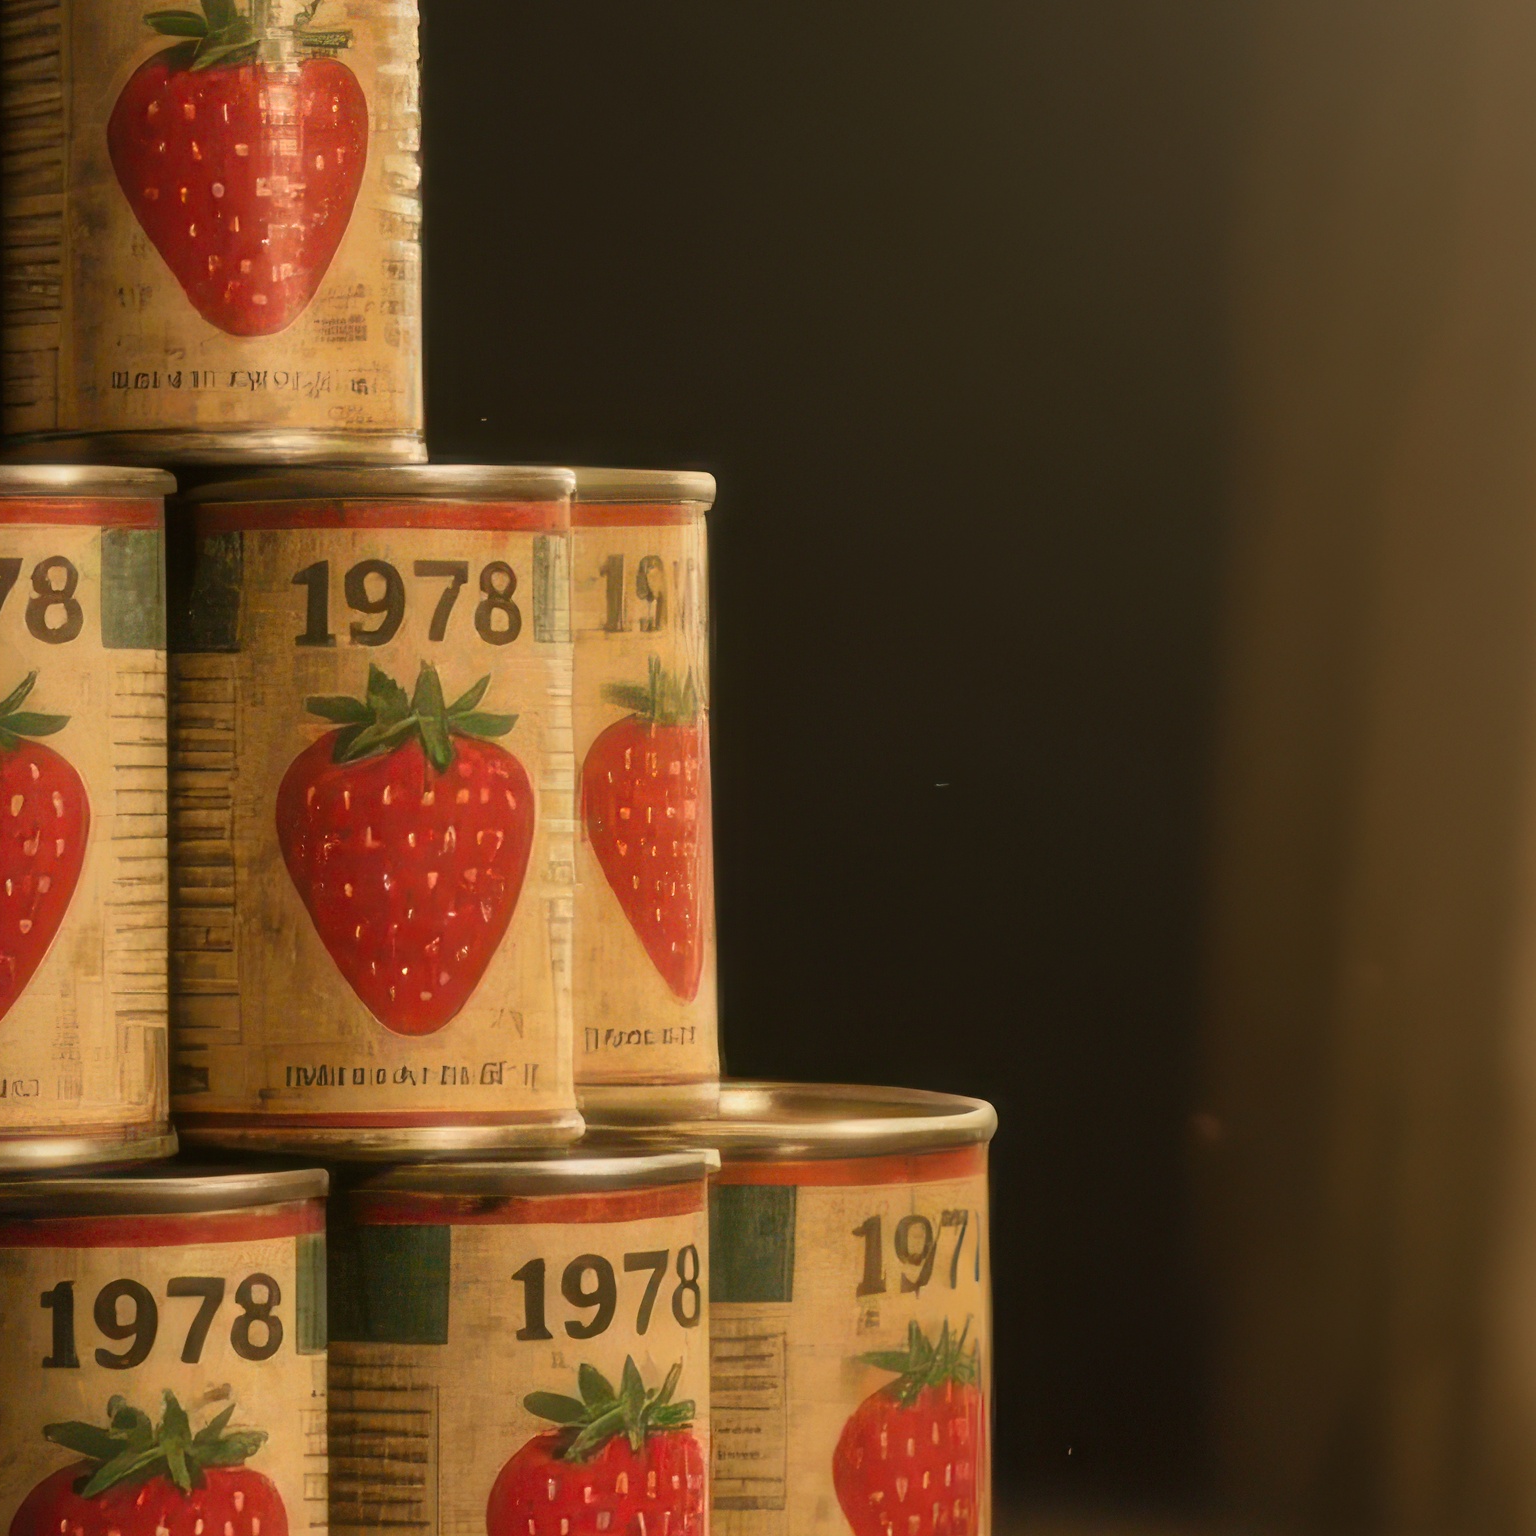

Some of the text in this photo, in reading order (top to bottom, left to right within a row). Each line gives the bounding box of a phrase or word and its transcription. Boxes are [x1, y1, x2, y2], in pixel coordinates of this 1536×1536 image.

[292, 559, 522, 647] 1978
[598, 553, 695, 633] 19
[514, 1244, 702, 1341] 1978
[853, 1208, 980, 1298] 197
[38, 1272, 284, 1370] 1978
